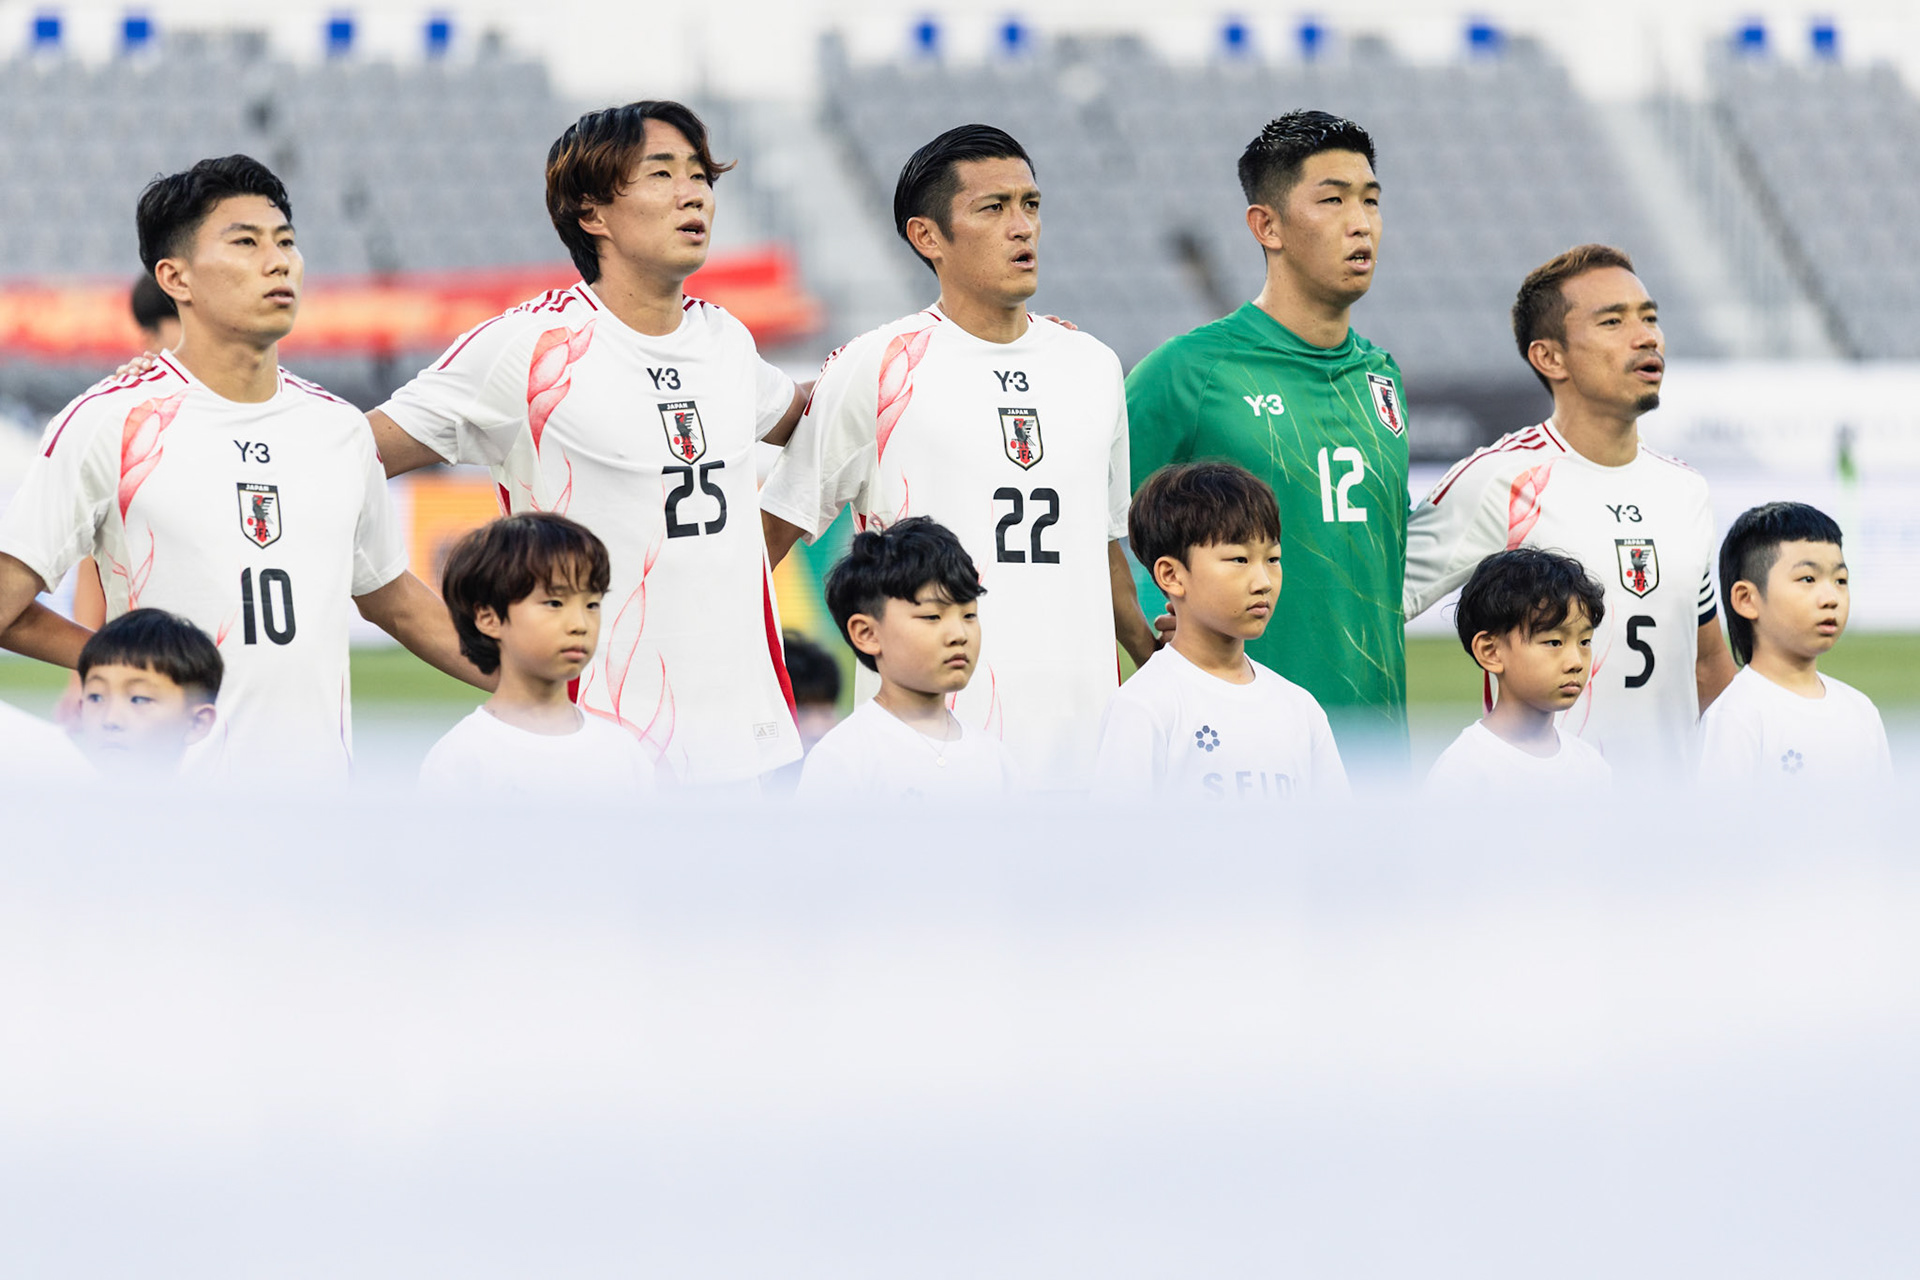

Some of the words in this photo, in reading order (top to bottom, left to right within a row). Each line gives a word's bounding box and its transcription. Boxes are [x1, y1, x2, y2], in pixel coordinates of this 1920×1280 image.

[680, 445, 698, 455] JFA
[1016, 450, 1034, 460] JFA
[245, 484, 269, 492] JAPAN
[661, 460, 727, 539] 25
[1317, 447, 1367, 522] 12
[253, 528, 271, 537] JFA
[993, 487, 1060, 564] 22
[1630, 579, 1649, 588] JFA
[241, 567, 296, 646] 10
[1624, 615, 1656, 688] 5
